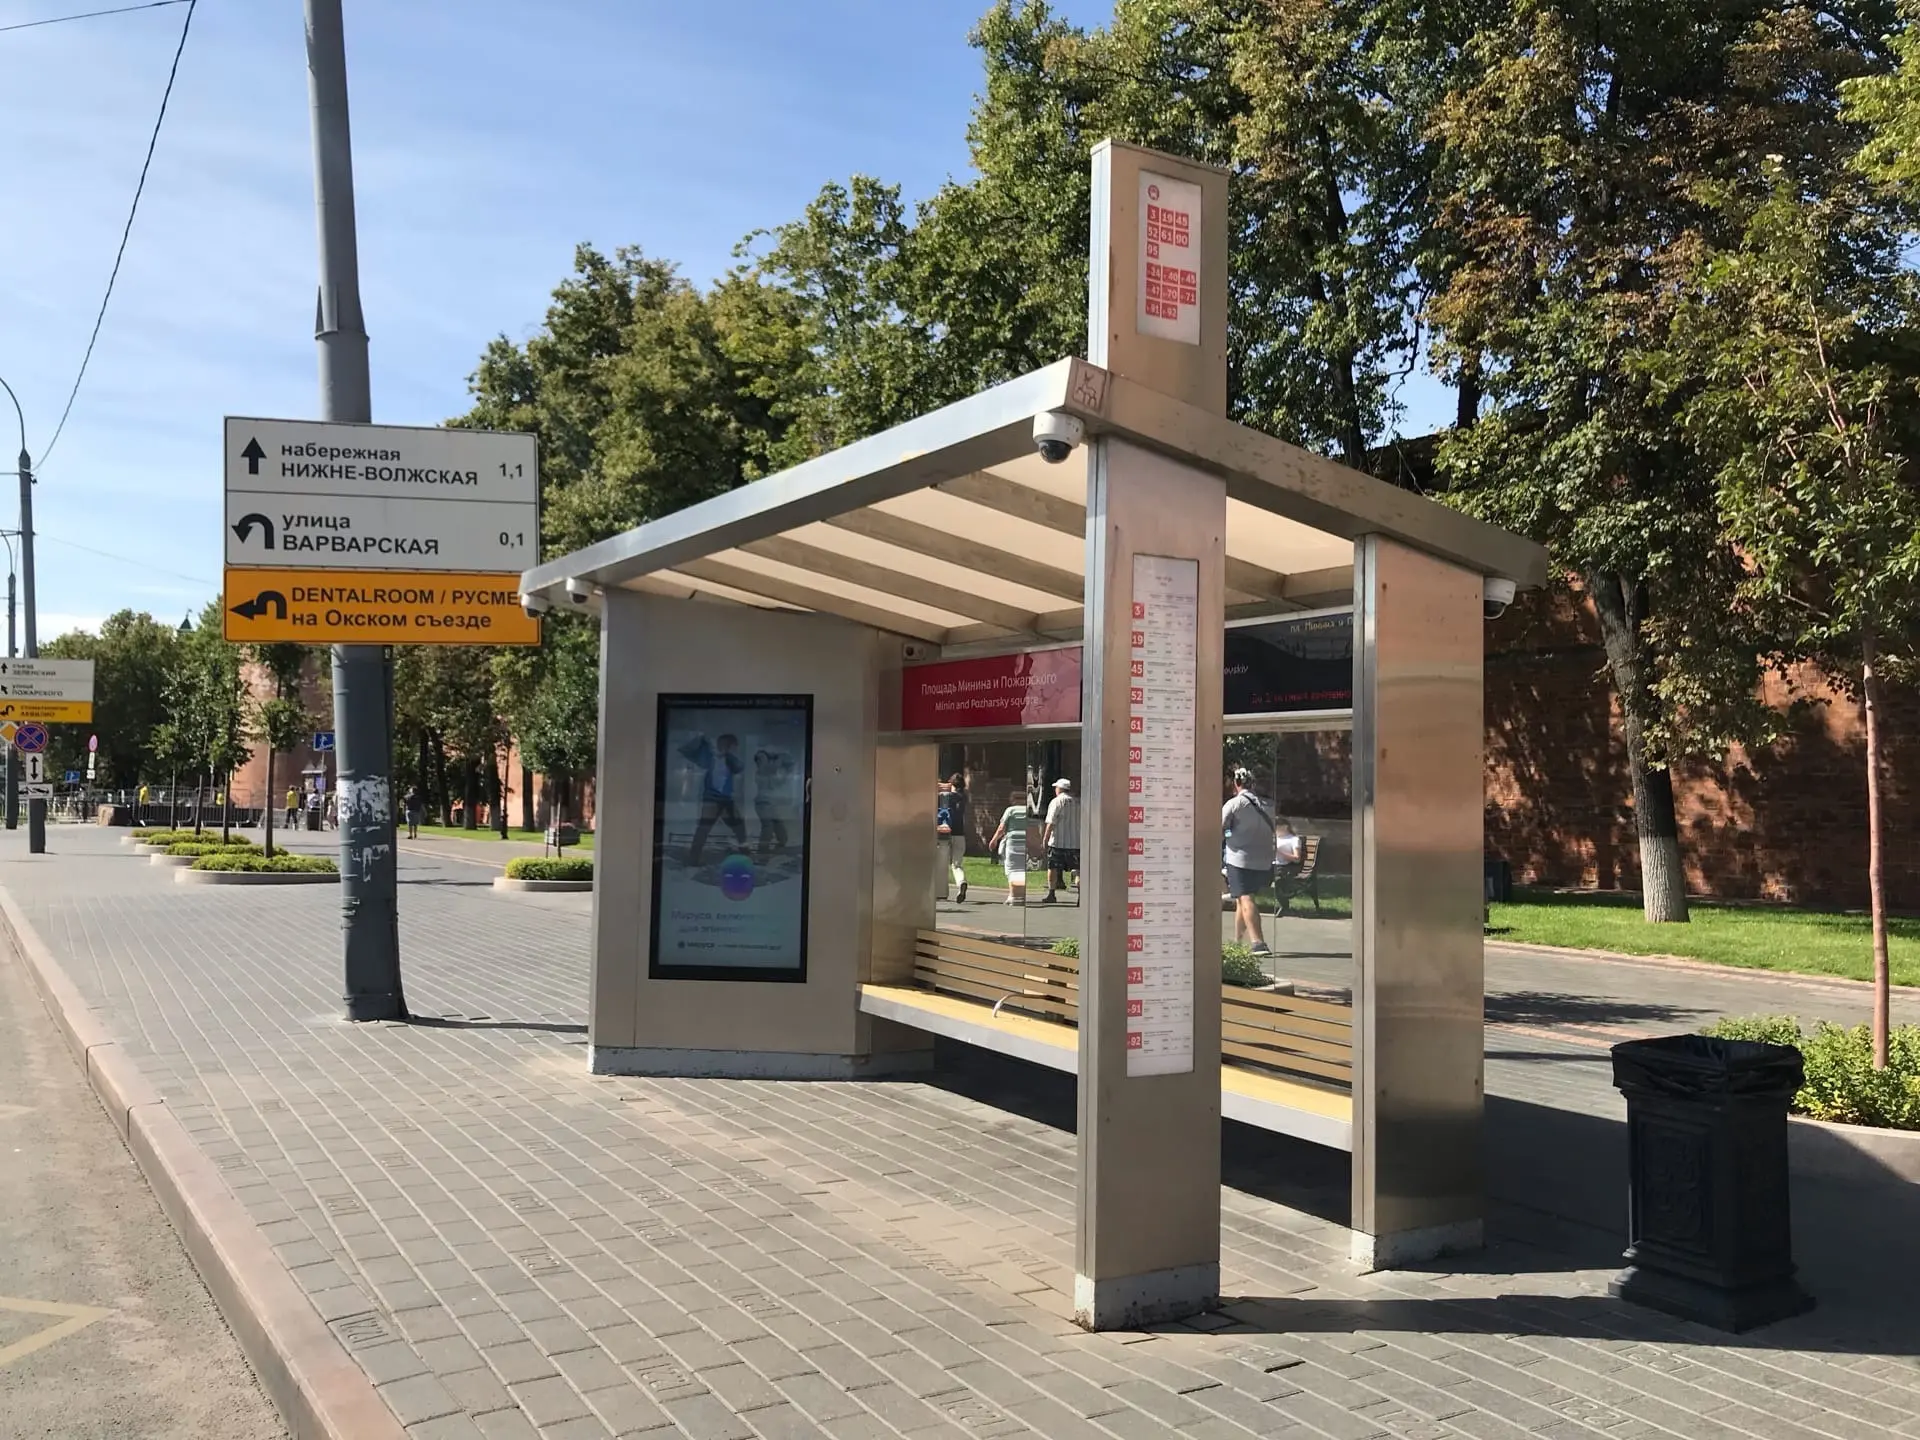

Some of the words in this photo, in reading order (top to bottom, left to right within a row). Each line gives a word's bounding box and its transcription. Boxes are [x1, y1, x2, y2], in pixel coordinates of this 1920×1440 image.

[1162, 212, 1172, 223] 19
[1176, 216, 1188, 226] 45
[1148, 227, 1158, 238] 52
[1161, 230, 1172, 241] 61
[1176, 234, 1188, 245] 90
[1148, 245, 1158, 256] 95
[281, 443, 401, 461] набережная
[281, 462, 478, 485] НИЖНЕ-ВОЛЖСКАЯ
[499, 463, 523, 479] 1,1
[282, 513, 351, 531] улица
[283, 535, 439, 555] ВАРВАРСКАЯ
[499, 532, 524, 548] 0,1
[292, 587, 437, 605] DENTALROOM
[440, 590, 446, 605] /
[452, 590, 522, 607] РУСМЕ
[1134, 606, 1141, 614] 3
[292, 614, 317, 627] на
[325, 609, 407, 627] Окском
[415, 613, 492, 628] съезде
[1132, 636, 1143, 645] 19
[1131, 664, 1142, 674] 45
[922, 682, 957, 696] Площадь
[958, 679, 991, 693] Минина
[993, 680, 999, 689] и
[1001, 673, 1058, 689] Пожарского
[1131, 690, 1142, 700] 52
[935, 700, 955, 712] Minin
[956, 699, 970, 710] and
[971, 696, 1010, 710] Pozharsky
[1011, 696, 1039, 706] square
[1130, 720, 1141, 730] 61
[1130, 750, 1140, 760] 90
[1130, 780, 1140, 790] 95
